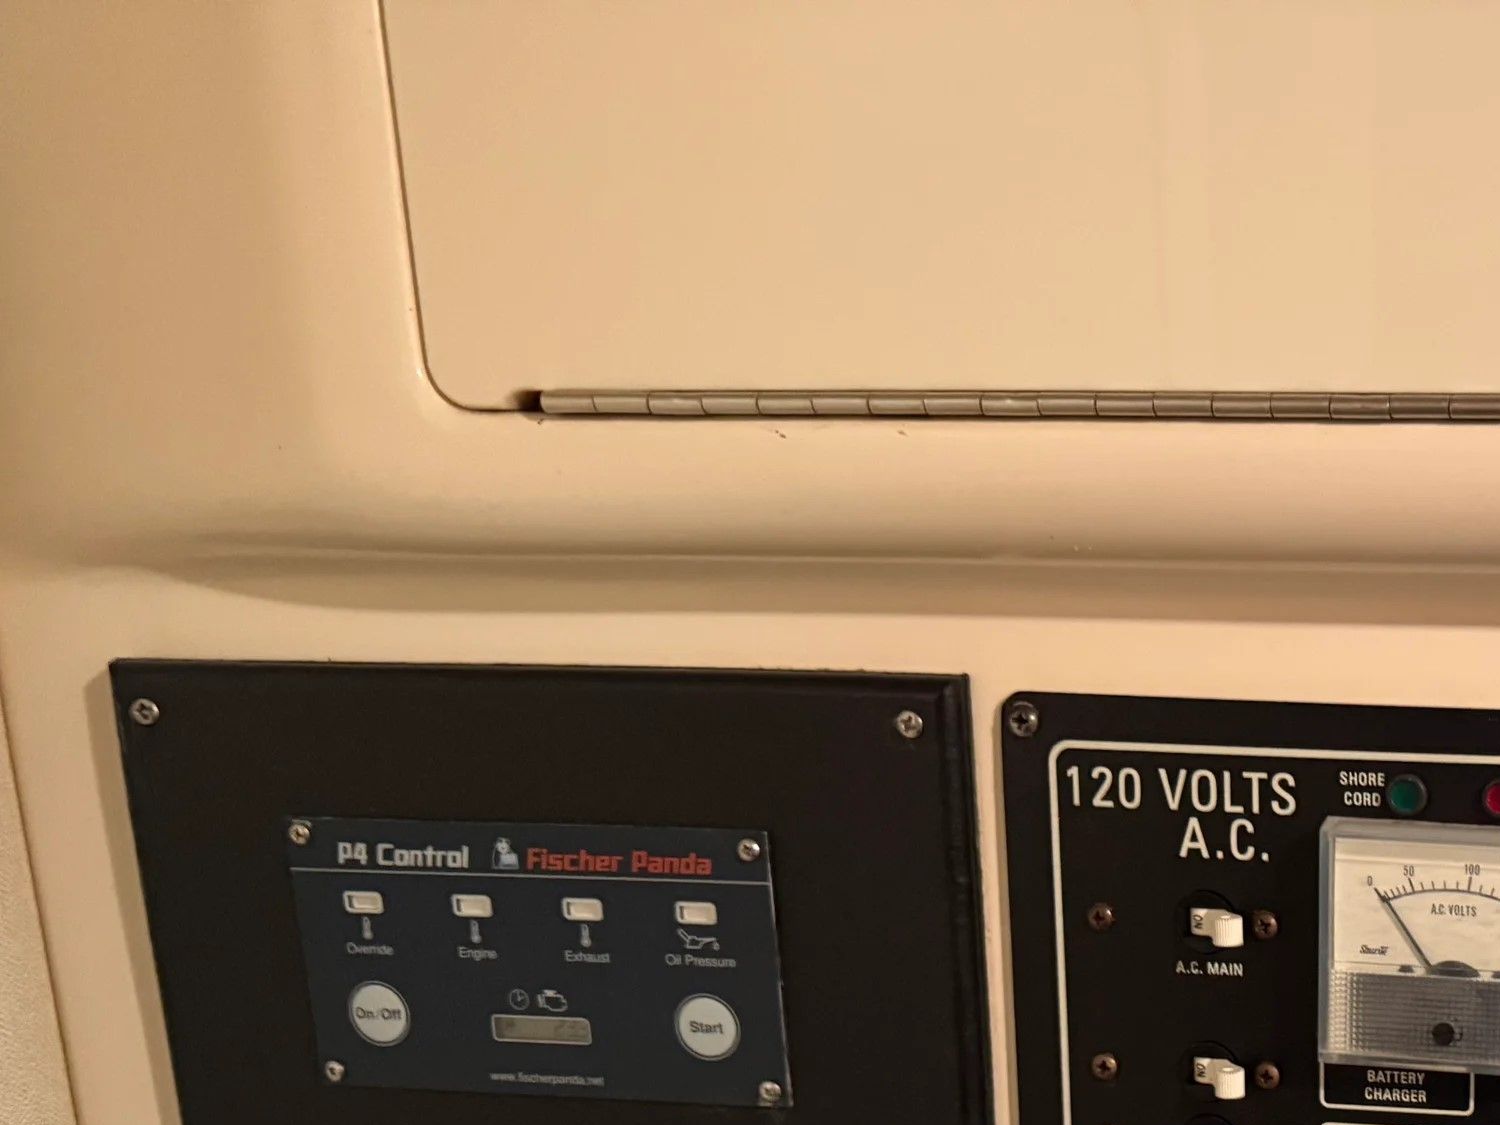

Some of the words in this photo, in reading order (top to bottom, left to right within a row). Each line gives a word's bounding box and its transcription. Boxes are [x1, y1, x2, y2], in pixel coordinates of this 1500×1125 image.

[1339, 771, 1385, 787] SHORE
[1066, 765, 1142, 810] 120
[1158, 768, 1296, 816] VOLTS
[1344, 791, 1381, 807] CORD
[1179, 817, 1269, 862] A.C.
[337, 842, 368, 865] P4
[376, 843, 469, 868] Control
[526, 848, 623, 873] Fischer
[631, 851, 712, 875] Panda
[1403, 865, 1415, 876] 50
[1464, 864, 1481, 876] 100
[1367, 876, 1373, 887] 0
[1448, 905, 1477, 917] VOLTS
[458, 946, 497, 961] Engine
[565, 950, 610, 963] Exhaust
[665, 954, 682, 966] Oil
[685, 955, 736, 968] Pressure
[1175, 961, 1203, 975] A.C.
[1207, 962, 1243, 977] MAIN
[690, 1020, 724, 1034] Start
[1367, 1069, 1425, 1085] BATTERY
[1364, 1087, 1427, 1103] CHARGER
